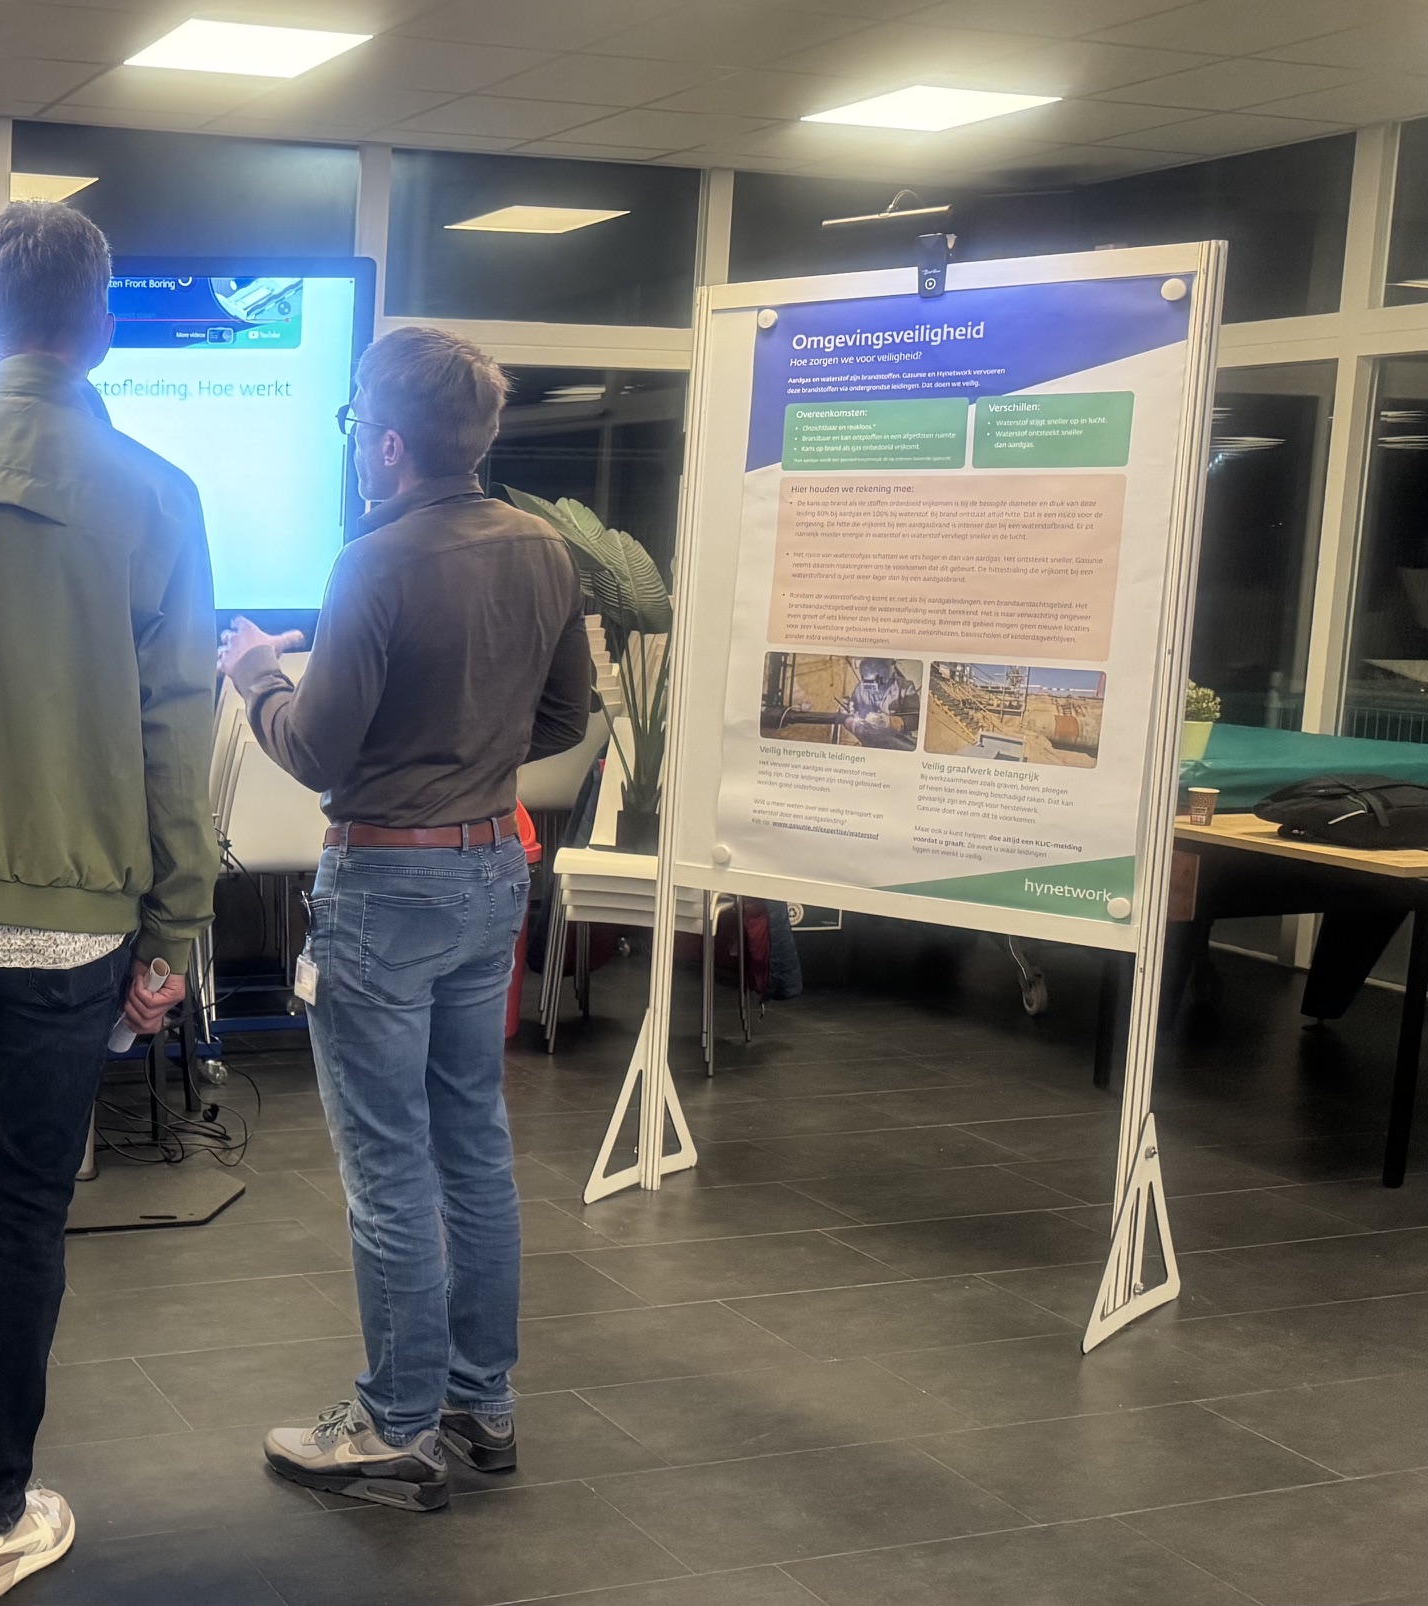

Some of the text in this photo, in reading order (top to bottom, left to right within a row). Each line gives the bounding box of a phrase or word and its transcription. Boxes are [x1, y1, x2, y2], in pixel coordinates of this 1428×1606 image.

[125, 279, 146, 288] Front
[149, 279, 175, 290] Boring
[792, 321, 984, 351] Omgevingsveiligheid
[790, 350, 922, 368] Hoe zorgen we voor veiligheid?
[788, 376, 811, 385] Aardgas
[821, 374, 849, 382] waterstof
[850, 374, 860, 382] zijn
[861, 372, 901, 380] brandstoffen.
[937, 369, 972, 378] Hynetwork
[802, 385, 839, 393] brandstoffen
[849, 383, 890, 393] ondergrondse
[891, 382, 921, 391] leidingen.
[962, 379, 980, 388] veilig.
[94, 379, 292, 401] stofleiding. Hoe werkt
[797, 408, 867, 418] Overeenkomsten:
[989, 402, 1040, 412] Verschillen:
[791, 485, 807, 493] Hier
[809, 485, 840, 493] houden
[856, 484, 891, 495] rekening
[893, 484, 914, 493] mee:
[760, 745, 865, 765] Veilig hergebruik leidingen
[922, 761, 1039, 782] Veilig graafwerk belangrijk
[772, 820, 879, 841] www.gasunie.nl/expertise/waterstof
[1025, 879, 1112, 904] hynetwork
